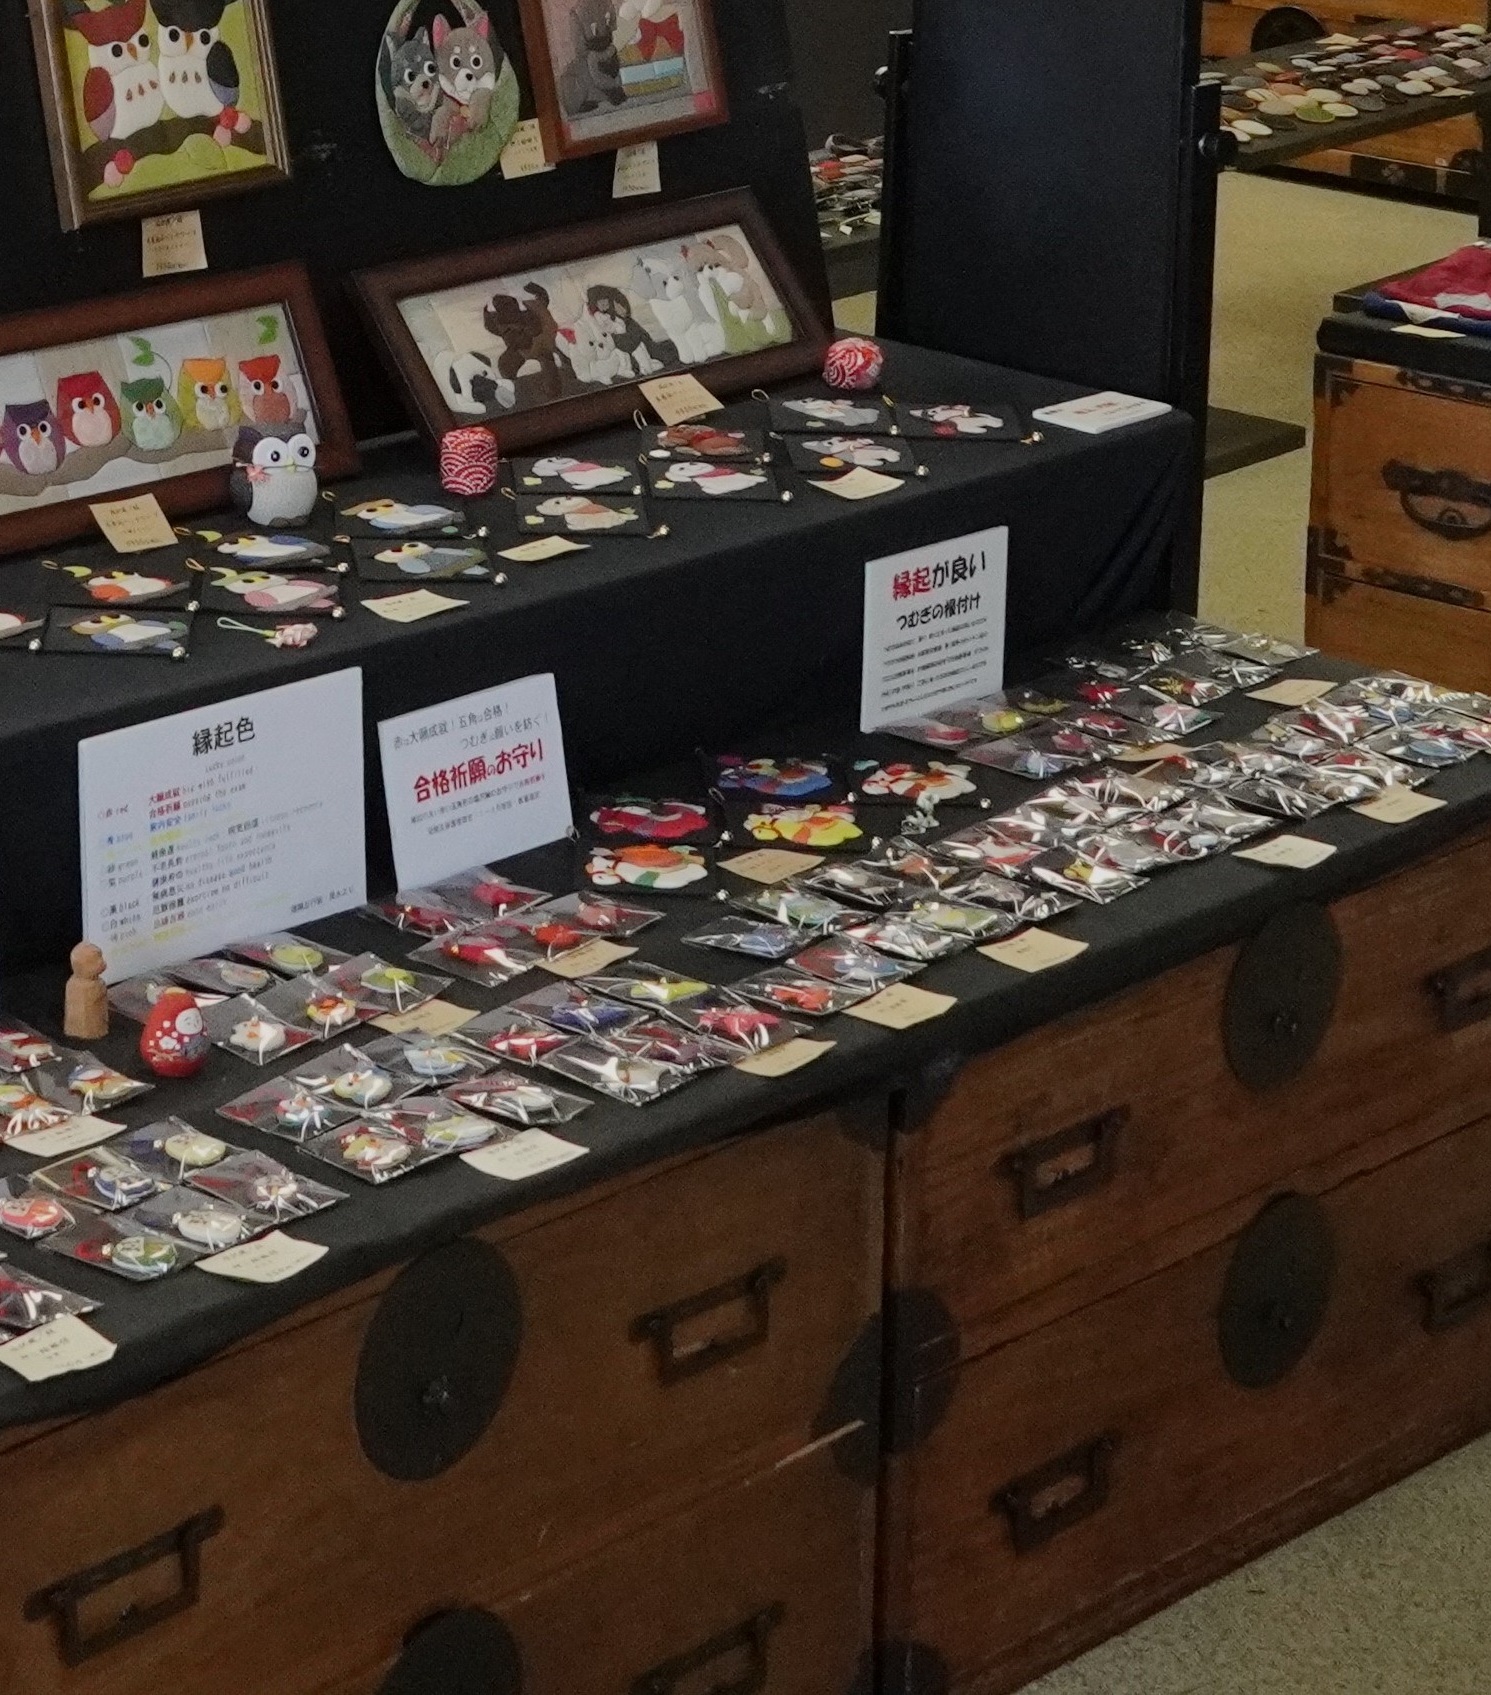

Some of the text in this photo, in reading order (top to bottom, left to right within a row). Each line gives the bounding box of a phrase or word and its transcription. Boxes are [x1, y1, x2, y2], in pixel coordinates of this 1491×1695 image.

[892, 550, 986, 601] 縁起が良い
[896, 591, 981, 630] つむぎの根付け
[191, 716, 256, 757] 縁起色
[413, 737, 544, 803] 合格祈願のお守り
